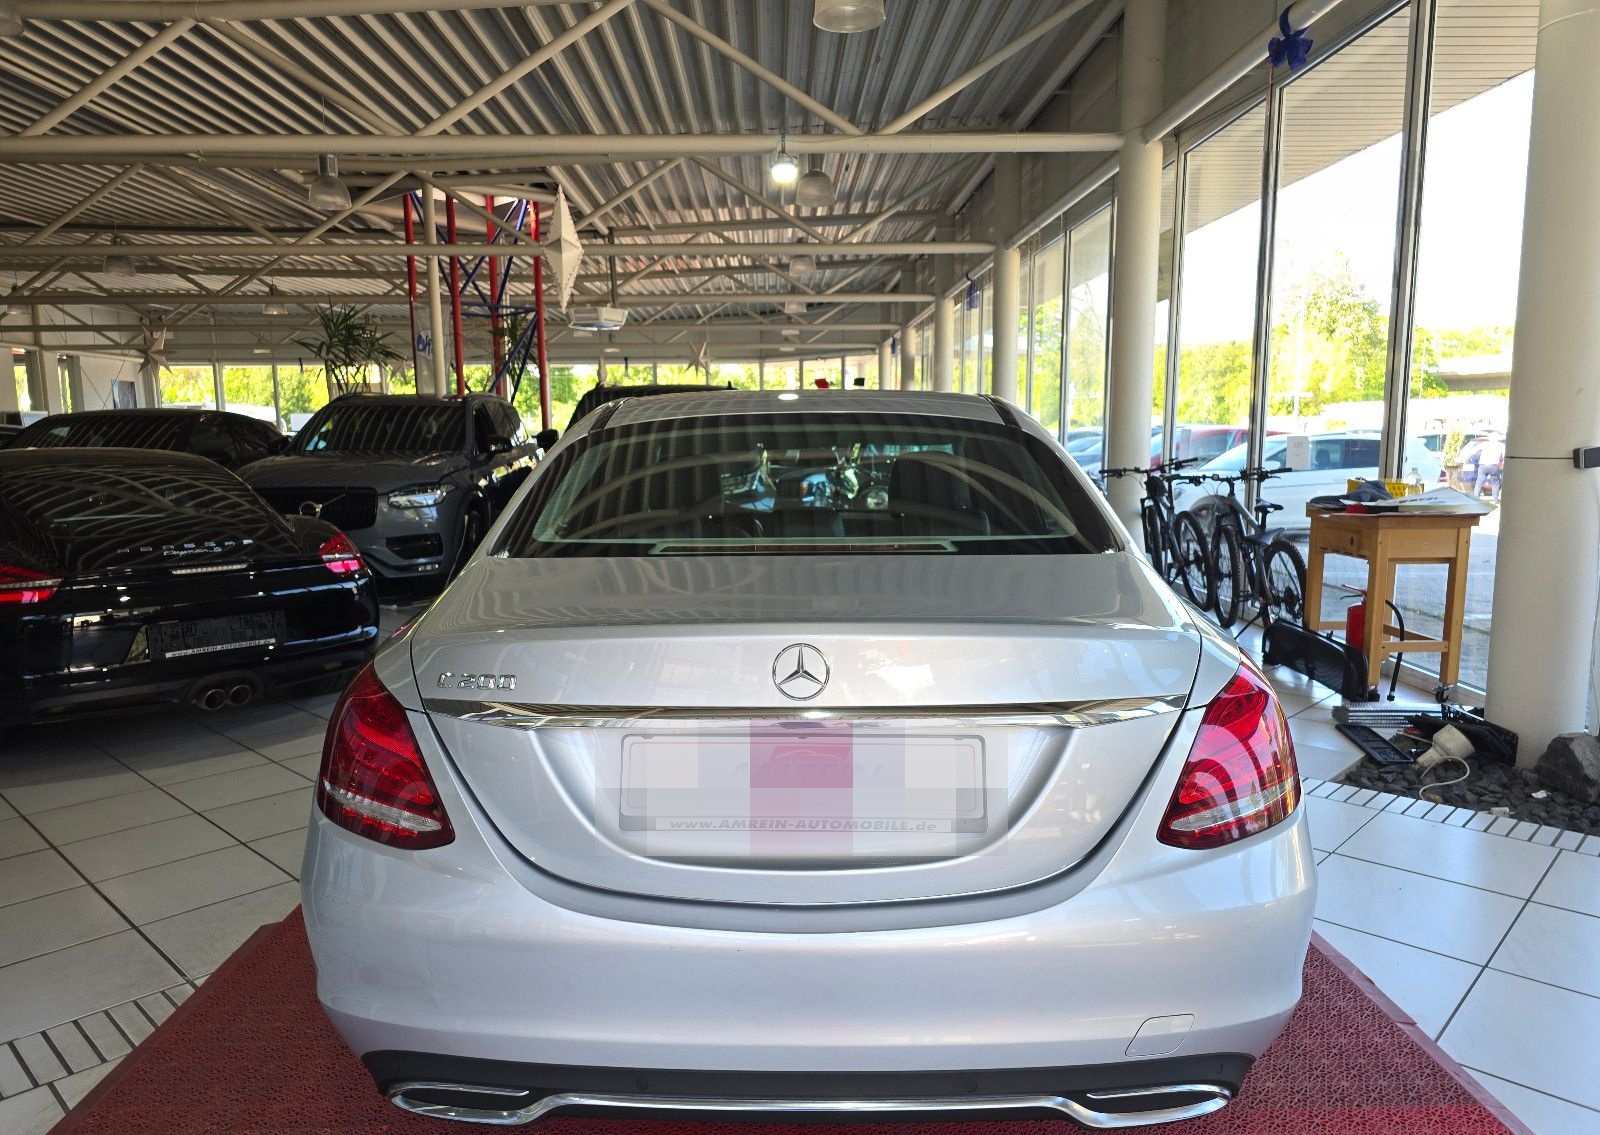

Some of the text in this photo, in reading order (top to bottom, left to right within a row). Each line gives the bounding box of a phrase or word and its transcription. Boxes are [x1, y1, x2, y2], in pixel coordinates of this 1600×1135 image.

[437, 671, 517, 690] C 200
[669, 816, 937, 831] www.AMREIN-AUTOMOBILE.de
